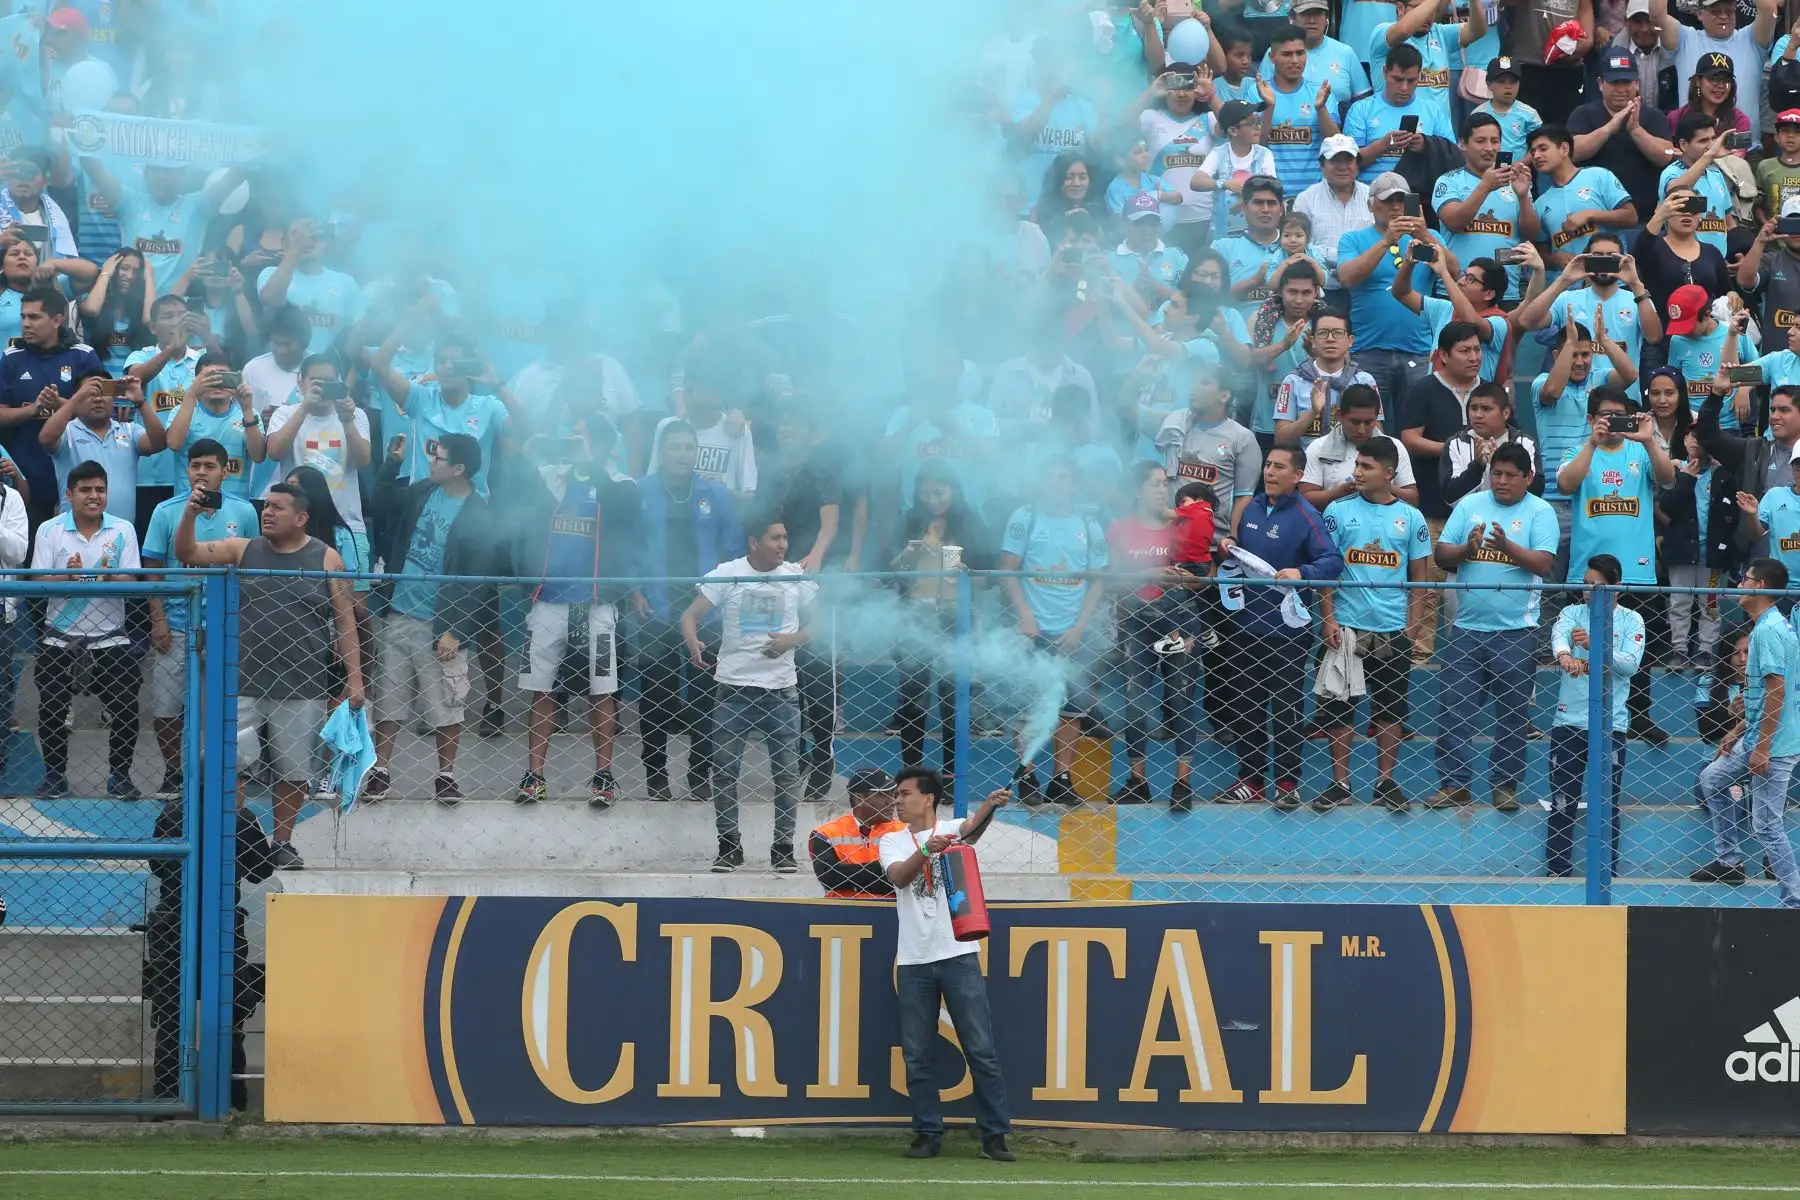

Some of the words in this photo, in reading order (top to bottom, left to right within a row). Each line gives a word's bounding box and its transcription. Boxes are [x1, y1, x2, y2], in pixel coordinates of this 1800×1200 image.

[1268, 130, 1306, 141] CRISTAL
[1593, 501, 1636, 513] CRISTAL
[1350, 550, 1396, 565] CRISTAL
[1471, 548, 1513, 563] RISTA
[1341, 935, 1386, 957] M.R.
